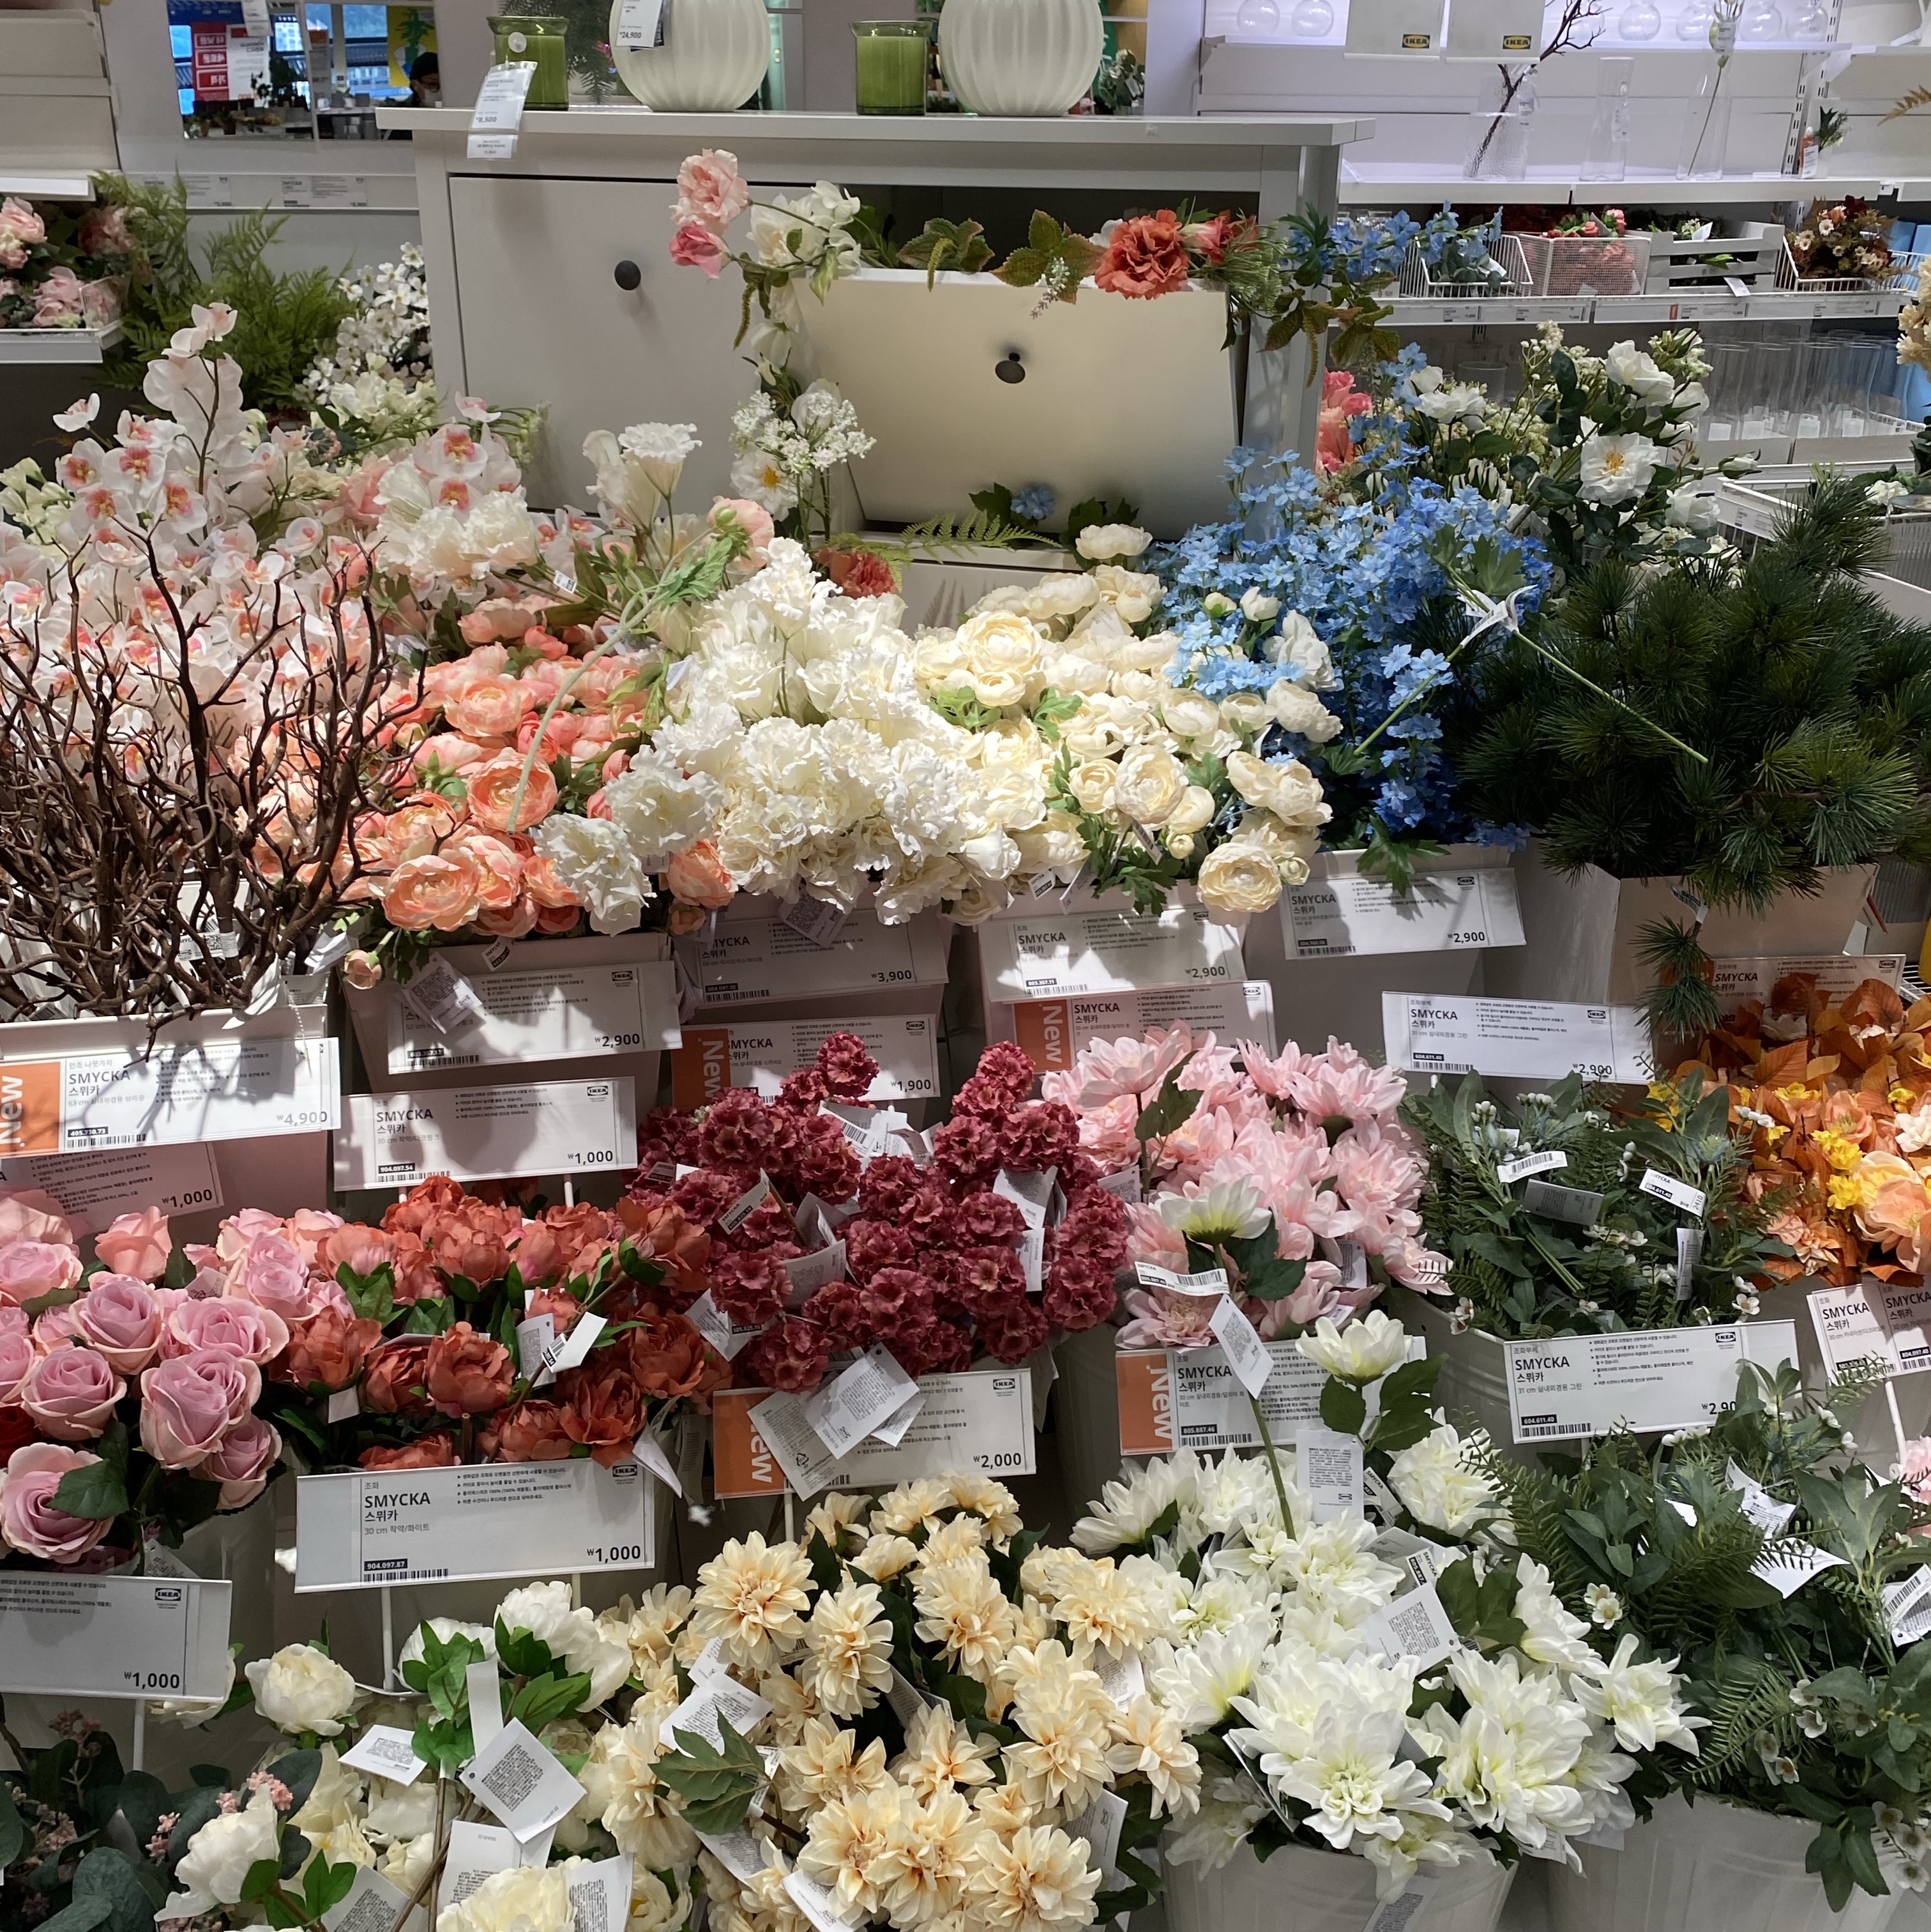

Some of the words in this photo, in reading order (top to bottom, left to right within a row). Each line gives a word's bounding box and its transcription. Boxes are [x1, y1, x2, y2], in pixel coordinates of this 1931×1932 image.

[1291, 894, 1337, 905] SMYCKA
[1293, 906, 1315, 914] 스뮈카
[1018, 932, 1066, 945] SMYCKA
[702, 949, 727, 959] 스뮈카
[1020, 945, 1044, 954] 스뮈카
[1715, 973, 1759, 982] SMYCKA
[1074, 1003, 1120, 1014] SMYCKA
[1411, 1008, 1458, 1020] SMYCKA
[1075, 1014, 1098, 1023] 스뮈카
[1411, 1020, 1435, 1029] 스뮈카
[68, 1070, 131, 1084] SMYCKA
[68, 1085, 100, 1097] 스뮈카
[376, 1108, 434, 1123] SMYCKA
[70, 1128, 106, 1136] 405.730.73
[377, 1123, 405, 1134] 스뮈카
[568, 1150, 614, 1166] ₩1,000
[162, 1189, 213, 1208] ₩1,000
[1692, 1195, 1704, 1210] 2410
[722, 1203, 740, 1222] SMYCKA
[1886, 1291, 1931, 1308] SMYCKA
[1822, 1302, 1870, 1320] SMYCKA
[1889, 1308, 1914, 1320] 스뮈카
[1826, 1319, 1850, 1331] 스뮈카
[1176, 1355, 1188, 1363] 조화
[1515, 1356, 1570, 1371] SMYCKA
[1178, 1365, 1232, 1379] SMYCKA
[1517, 1372, 1544, 1383] 스뮈카
[1179, 1381, 1206, 1392] 스뮈카
[1702, 1401, 1736, 1416] ₩2,90
[1524, 1416, 1555, 1424] 604.611.40
[973, 1453, 1022, 1469] ₩2,000
[1367, 1470, 1384, 1489] SMYCKA
[365, 1482, 379, 1490] 조화
[365, 1492, 431, 1509] SMYCKA
[365, 1509, 398, 1522] 스뮈카
[390, 1523, 430, 1533] 작약/화이트
[587, 1545, 640, 1564] ₩1,000
[367, 1561, 405, 1570] 904.097.87
[1423, 1551, 1438, 1577] SMYCKA
[124, 1671, 180, 1690] ₩1,000
